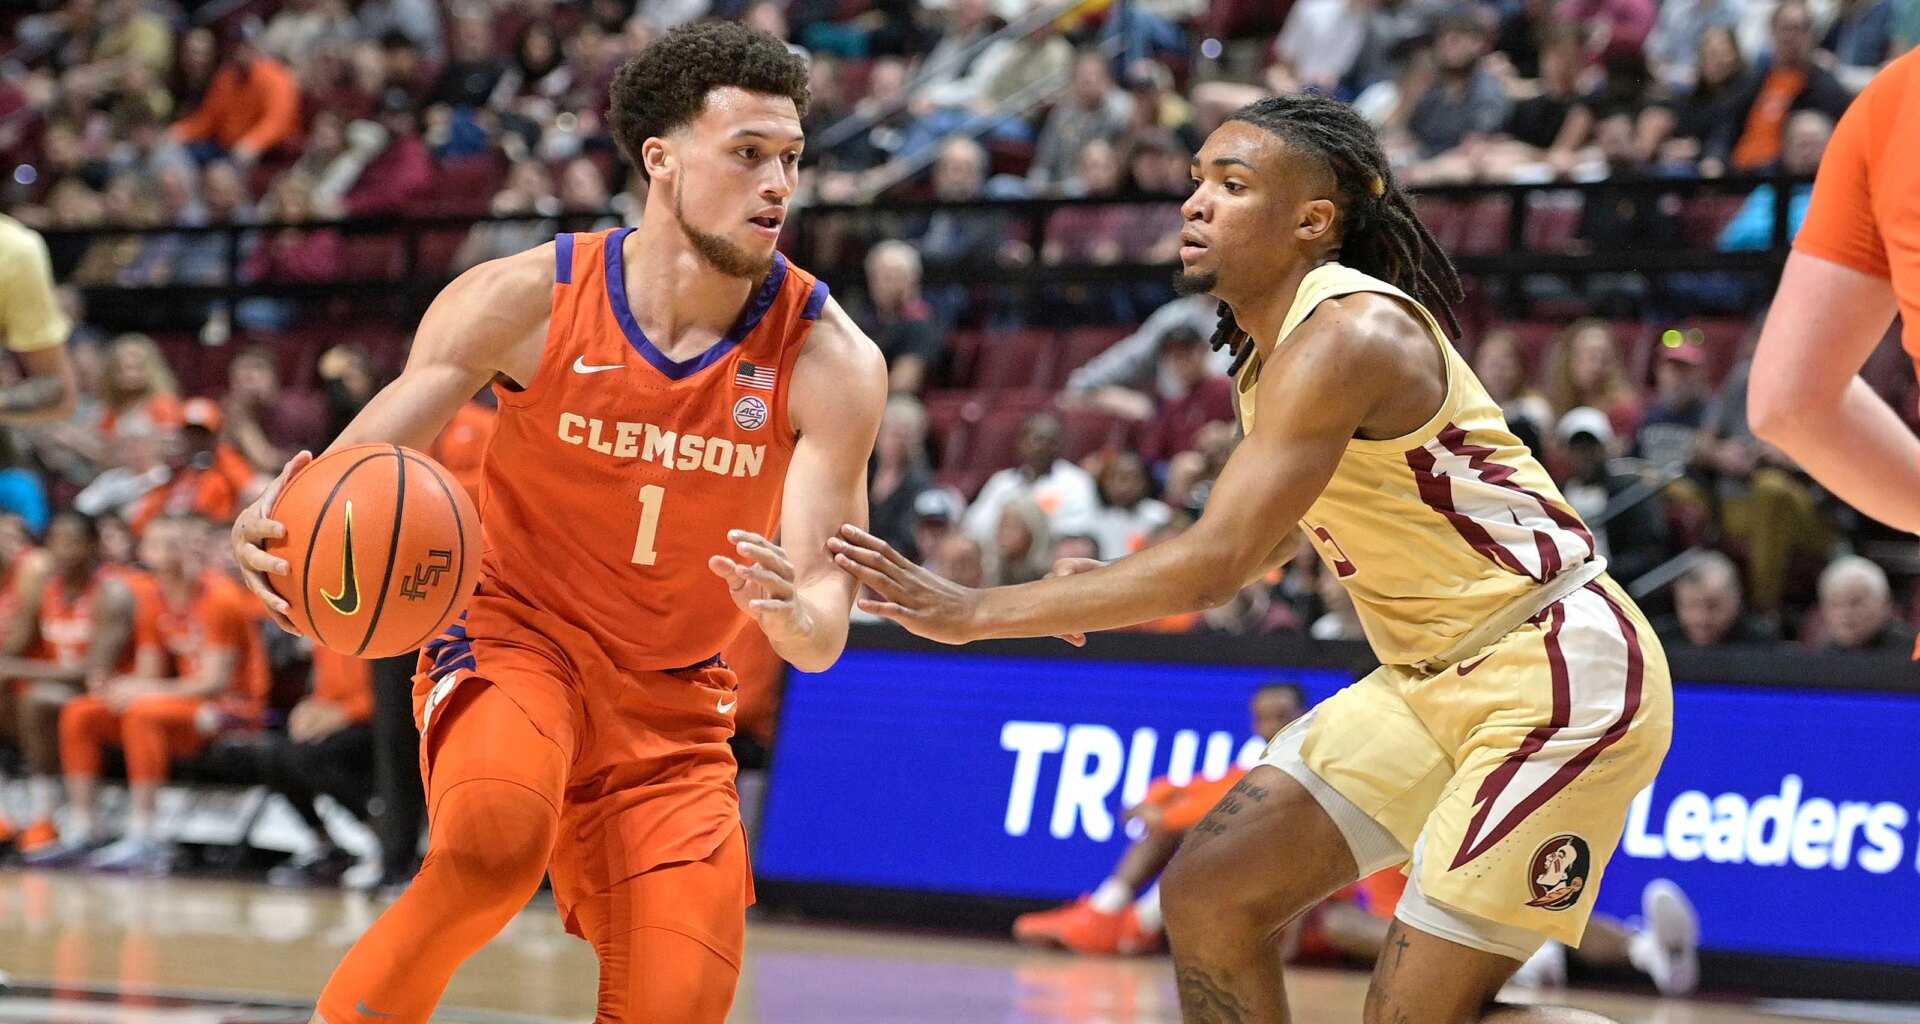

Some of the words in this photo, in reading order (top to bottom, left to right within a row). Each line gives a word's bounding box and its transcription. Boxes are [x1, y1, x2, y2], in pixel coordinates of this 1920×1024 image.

[557, 411, 767, 478] CLEMSON
[631, 484, 665, 566] 1
[400, 548, 453, 602] FSU
[1622, 772, 1910, 875] Leaders
